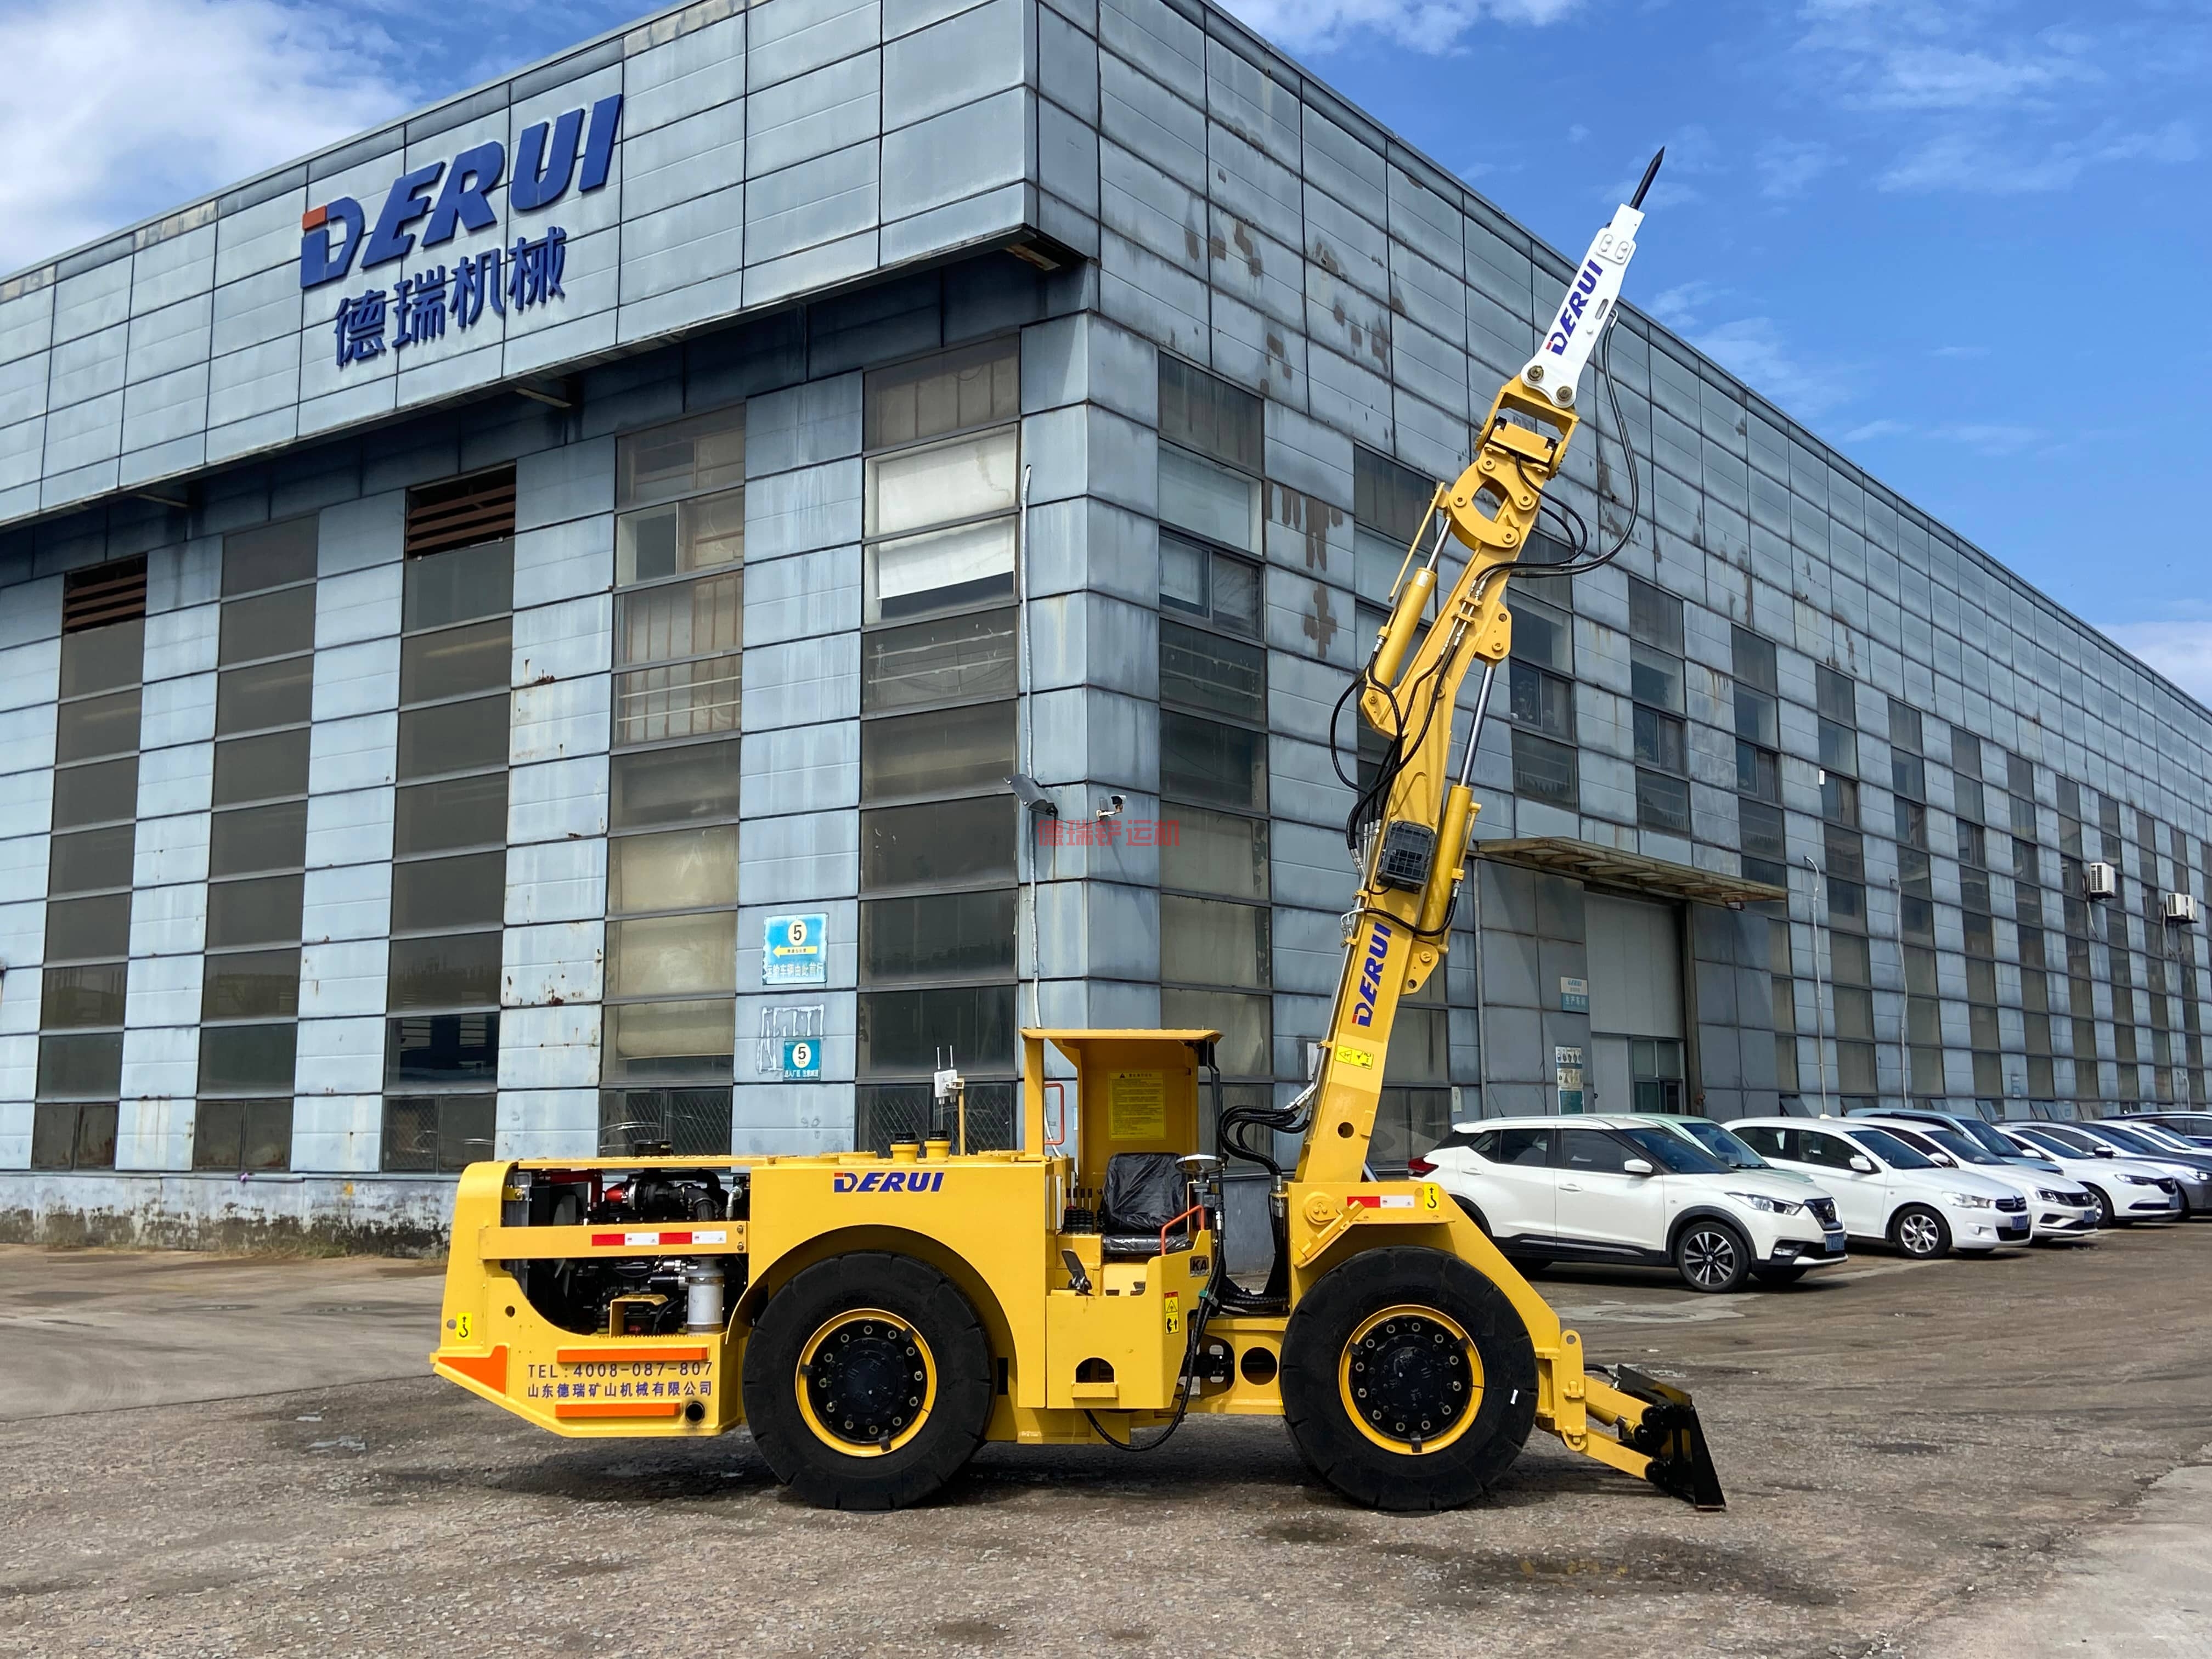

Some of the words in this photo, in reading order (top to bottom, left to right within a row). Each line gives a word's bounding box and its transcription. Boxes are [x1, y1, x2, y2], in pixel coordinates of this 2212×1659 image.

[301, 93, 624, 289] DERUI
[334, 225, 566, 367] 德瑞机械
[1545, 259, 1604, 356] DERUI
[793, 924, 802, 941] 5
[1351, 921, 1392, 1028] DERUI
[798, 1046, 806, 1060] 5
[833, 1172, 944, 1193] DERUI
[528, 1380, 712, 1398] 山东德瑞矿山机械有限公司
